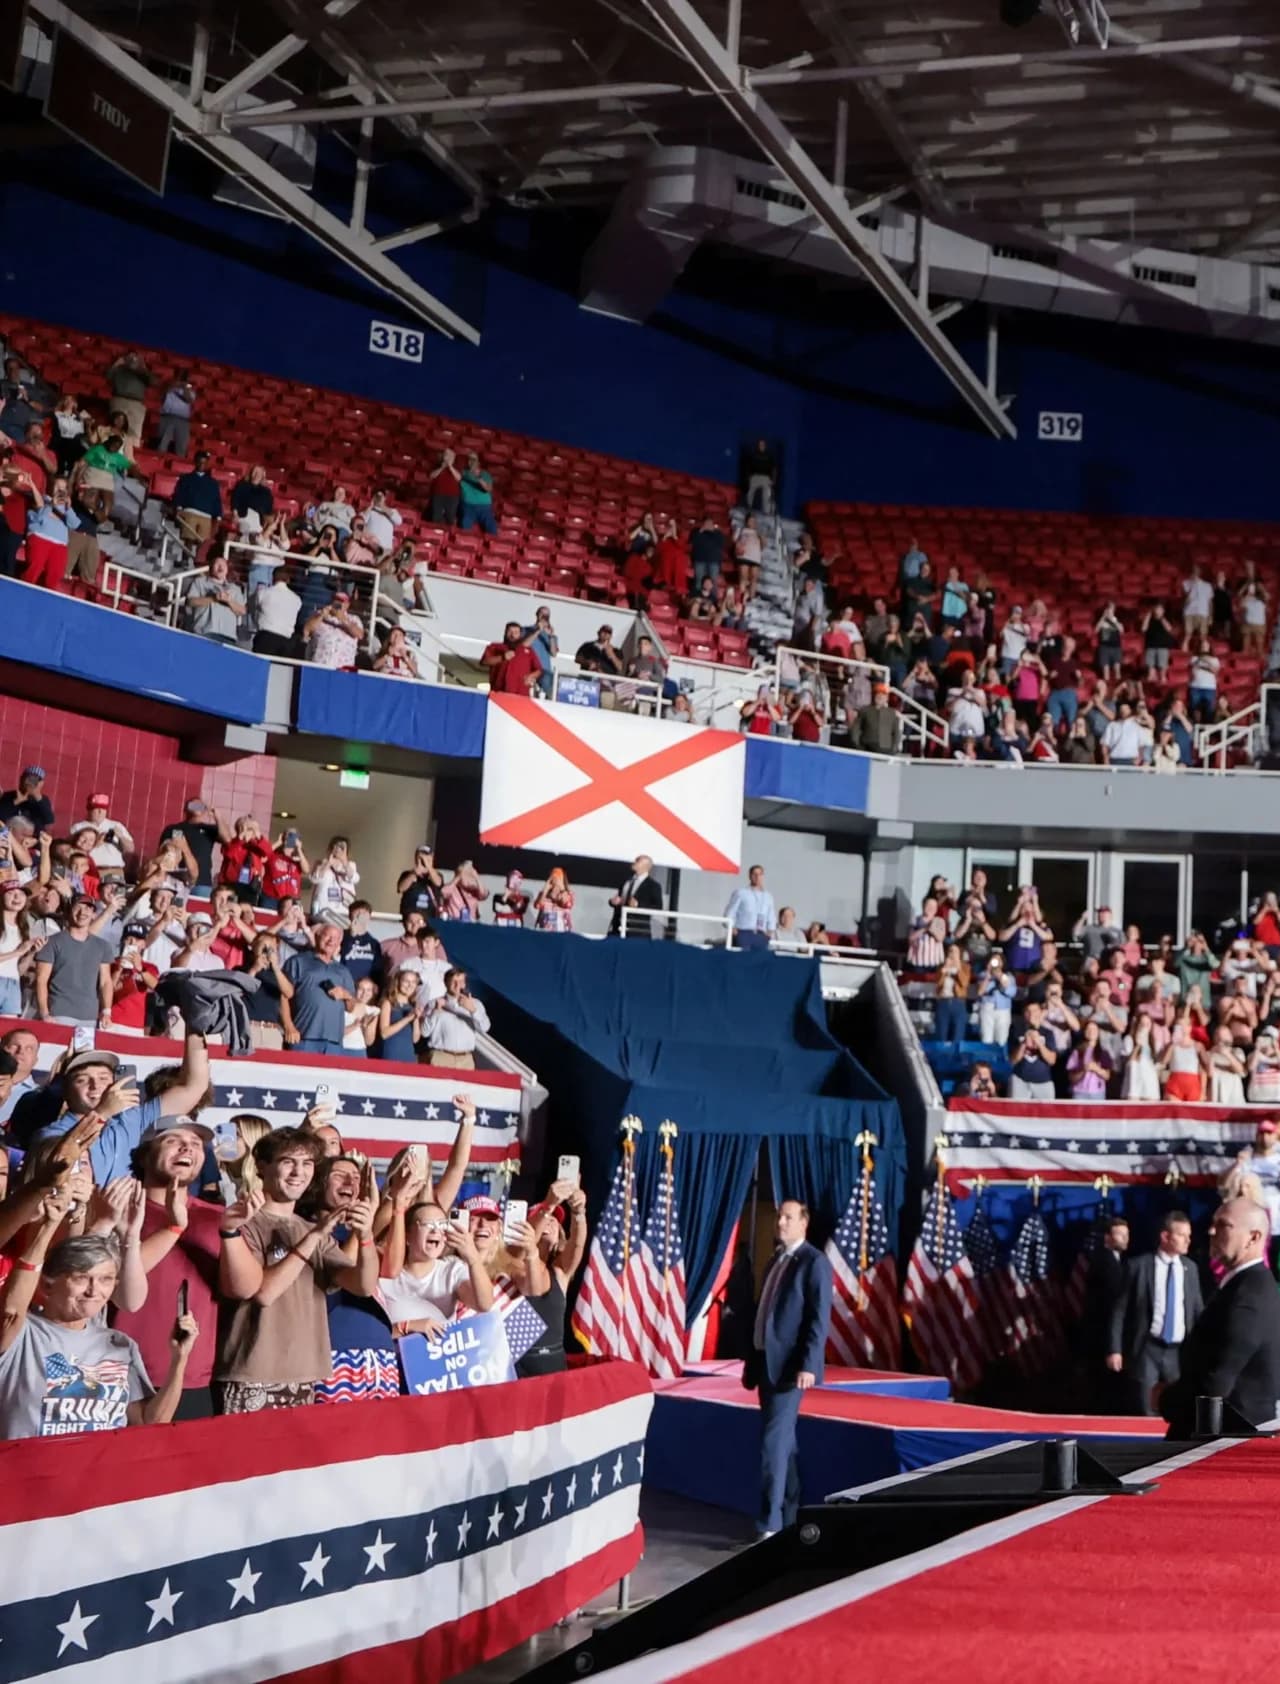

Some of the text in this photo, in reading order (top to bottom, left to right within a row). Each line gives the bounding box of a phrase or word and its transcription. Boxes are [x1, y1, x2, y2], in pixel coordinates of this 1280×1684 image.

[92, 92, 132, 134] TROY
[372, 326, 421, 357] 318
[1041, 415, 1080, 436] 319
[426, 1328, 481, 1360] TIPS
[445, 1354, 467, 1372] ON
[43, 1398, 127, 1425] TRUMP
[42, 1422, 88, 1436] FIGHT
